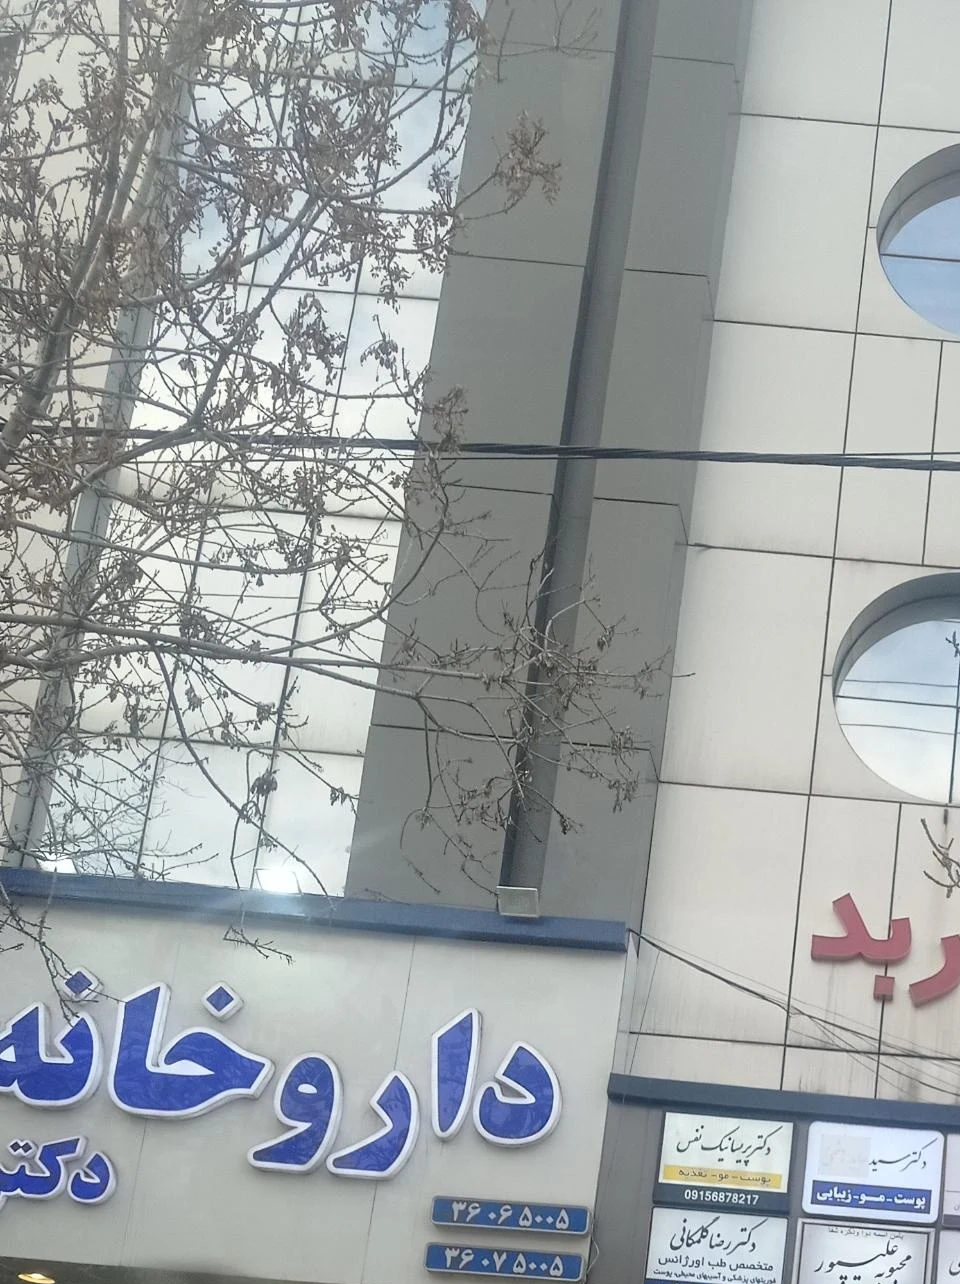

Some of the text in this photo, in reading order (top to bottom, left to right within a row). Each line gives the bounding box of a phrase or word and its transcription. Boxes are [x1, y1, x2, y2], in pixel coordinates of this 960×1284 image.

[0, 967, 563, 1180] داروخانه
[746, 1125, 783, 1159] دکتر
[899, 1137, 938, 1172] دکتر
[0, 1135, 117, 1212] دکت
[684, 1189, 759, 1206] 09156878217
[816, 1185, 926, 1210] پوست مو زیبایی
[451, 1200, 481, 1225] ۳۶
[519, 1206, 570, 1231] ۵۰۰۵
[709, 1232, 731, 1250] رضا
[726, 1218, 768, 1256] دکتر
[445, 1247, 564, 1276] ۳۶ ۰۷ ۵۰۰۵
[658, 1254, 774, 1272] متخصص طب اورژانس
